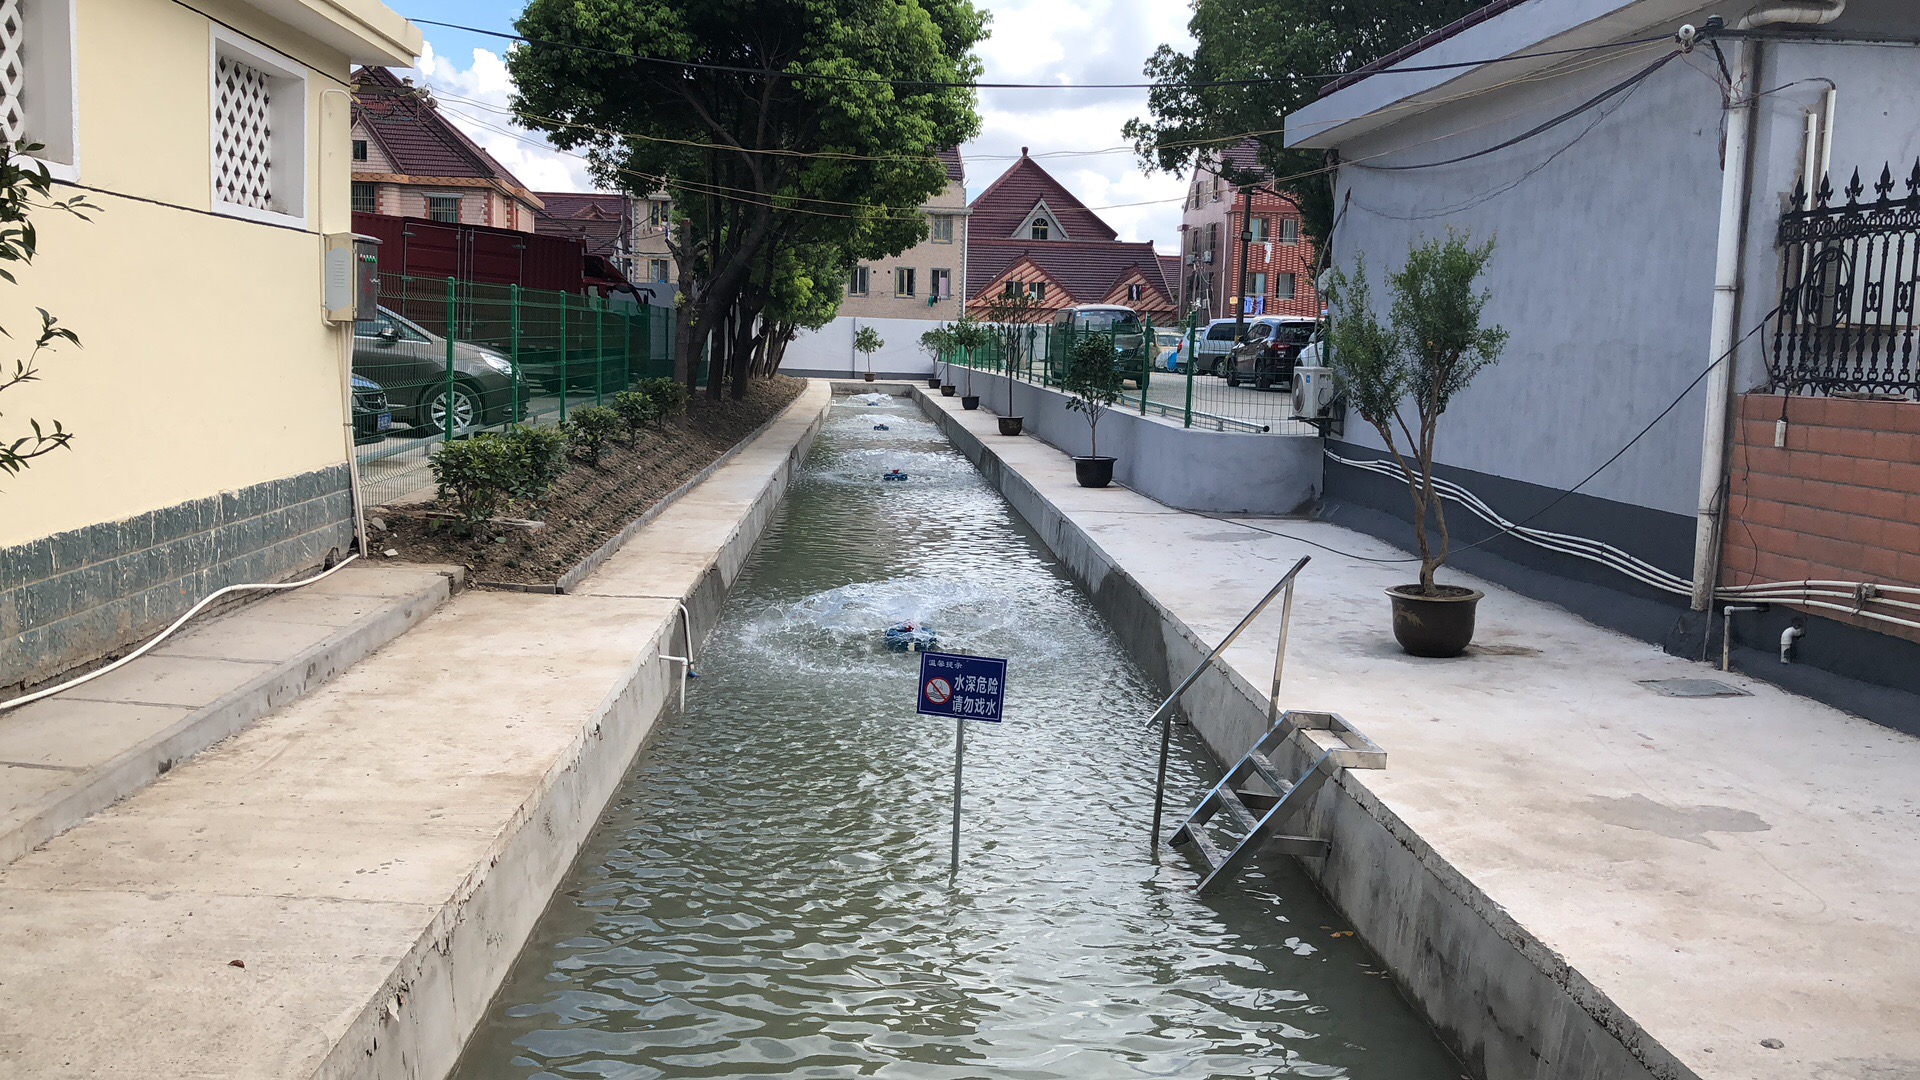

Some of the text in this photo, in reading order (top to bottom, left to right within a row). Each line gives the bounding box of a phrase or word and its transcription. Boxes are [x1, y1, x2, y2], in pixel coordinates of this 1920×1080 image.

[954, 673, 999, 695] 水深危险
[952, 694, 997, 716] 请勿戏水
